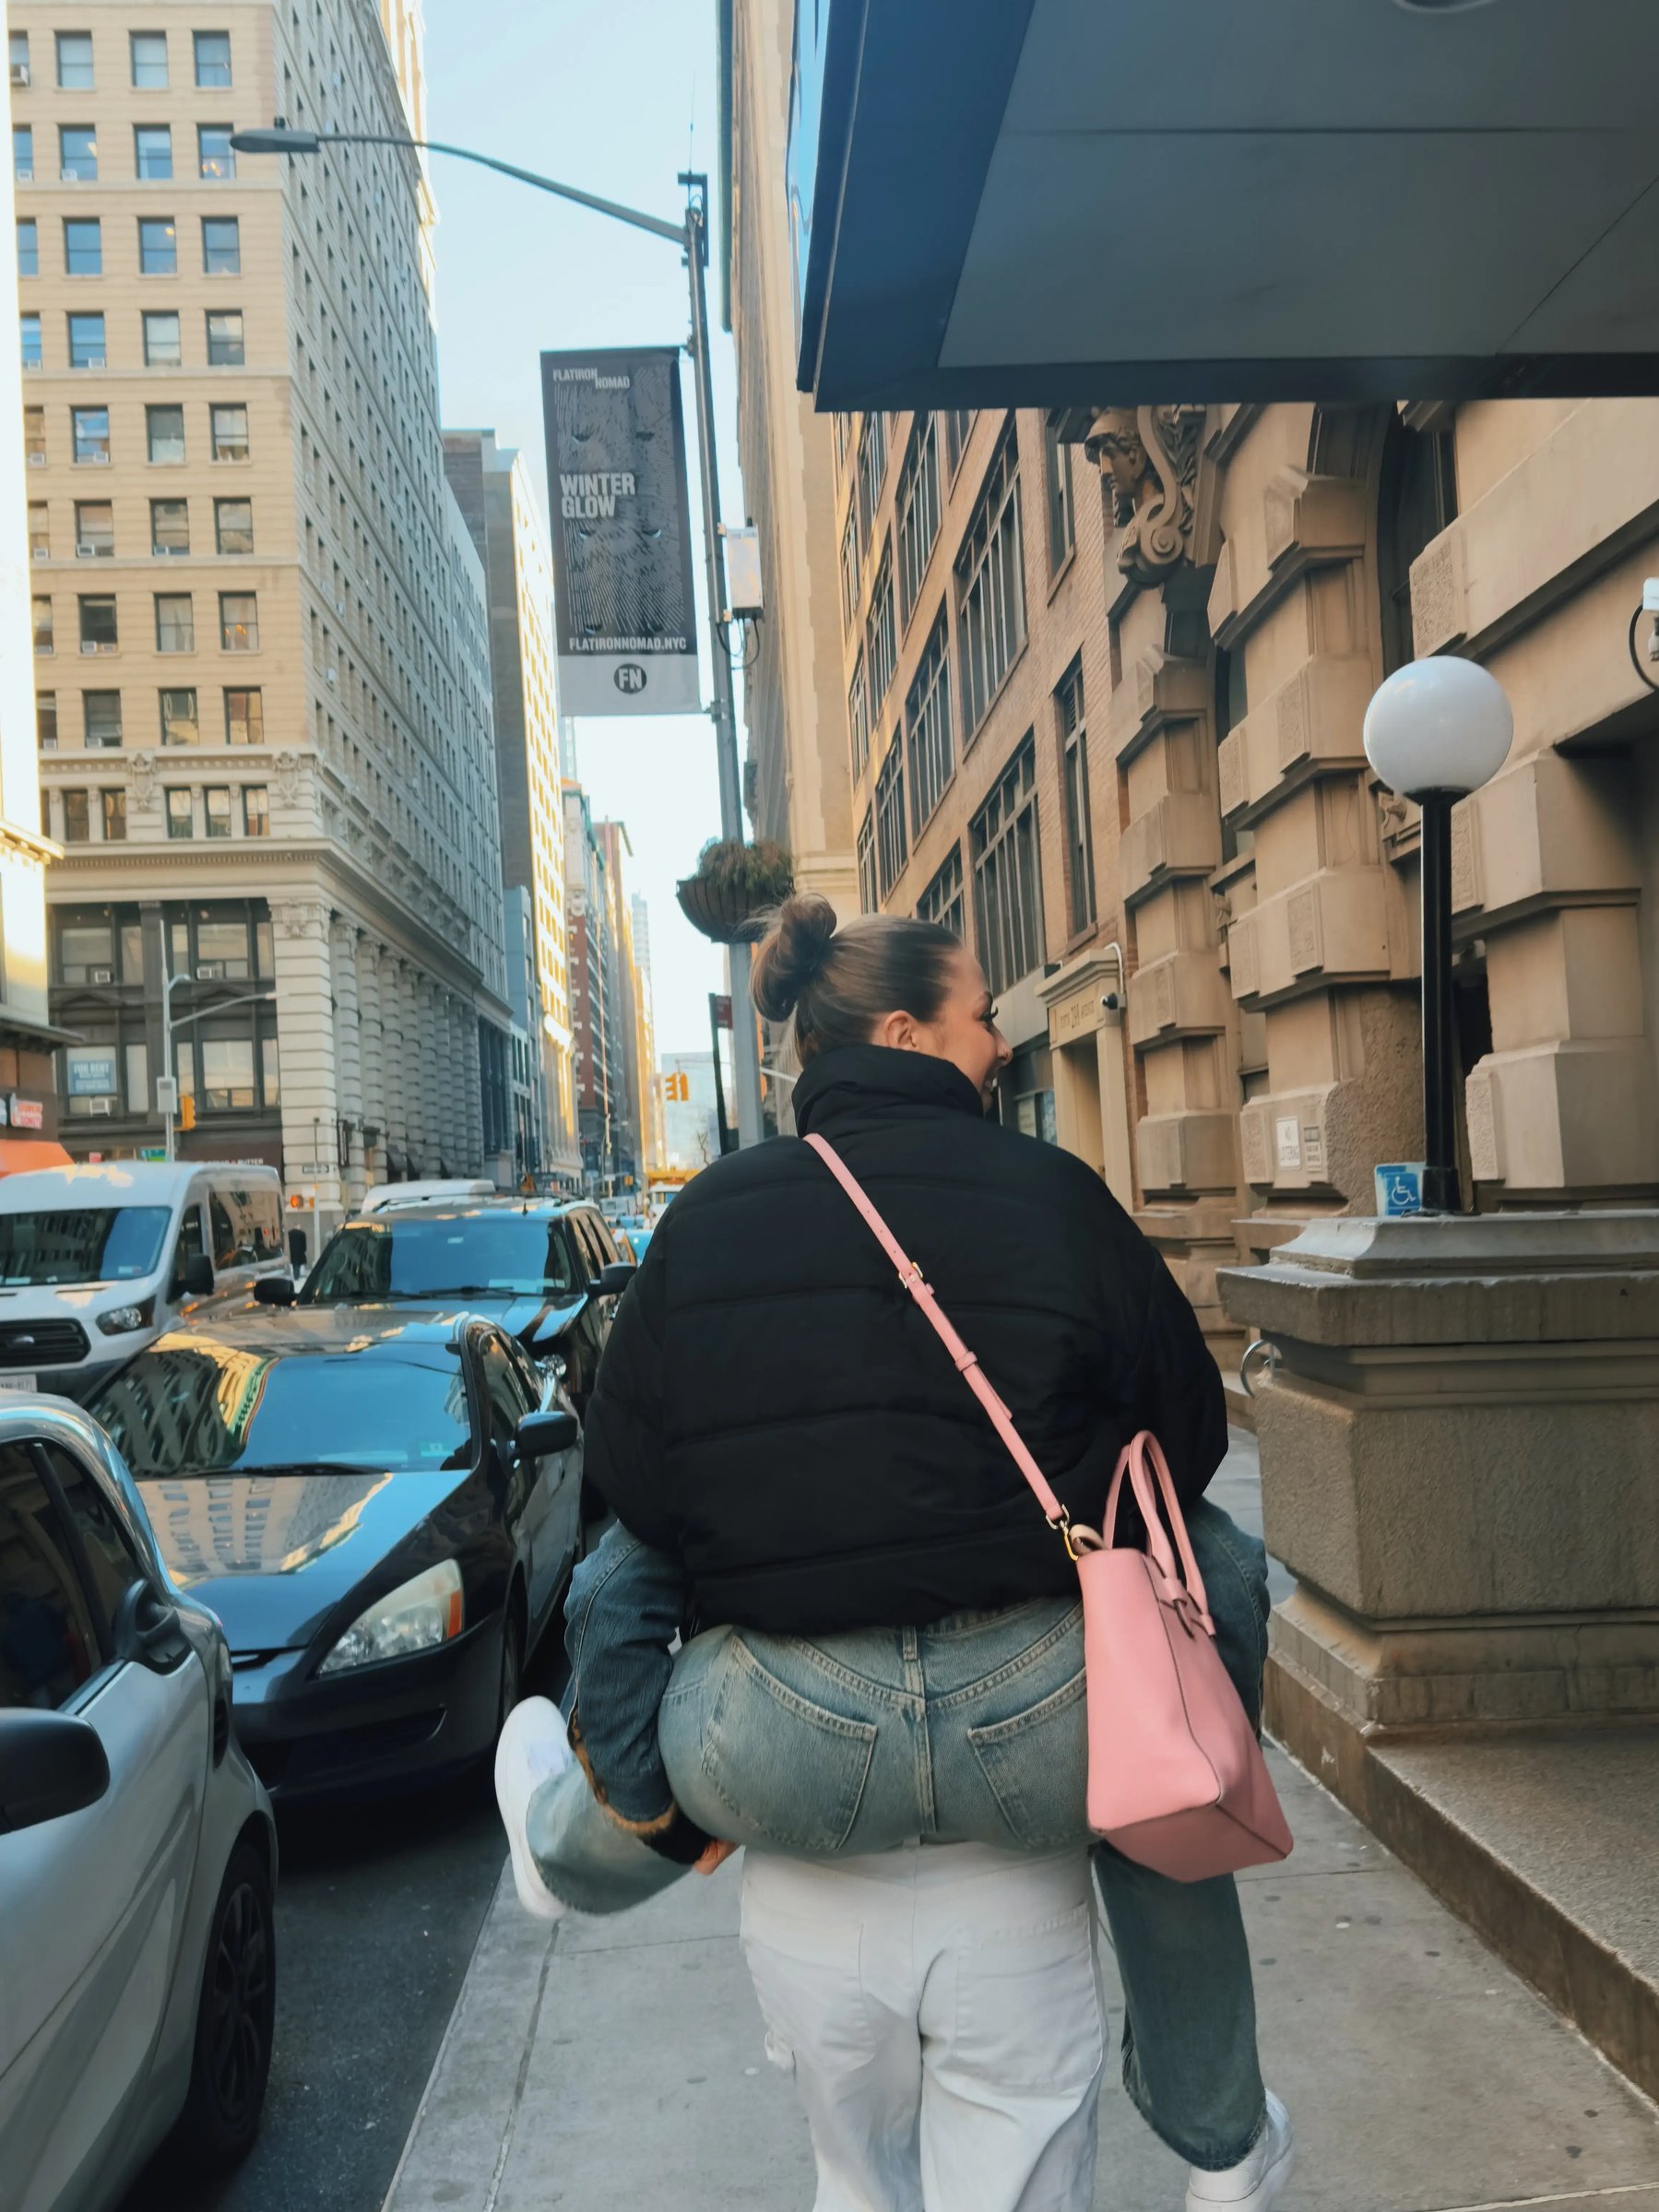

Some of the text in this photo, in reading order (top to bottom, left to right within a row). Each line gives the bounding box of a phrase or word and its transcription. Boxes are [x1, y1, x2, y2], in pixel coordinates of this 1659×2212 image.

[553, 368, 598, 382] FLATIRON
[595, 375, 630, 390] NOMAD
[560, 472, 635, 497] WINTER
[562, 494, 615, 518] GLOW
[569, 636, 686, 651] FLATIRONNOMAD.NYC
[618, 668, 643, 690] FN
